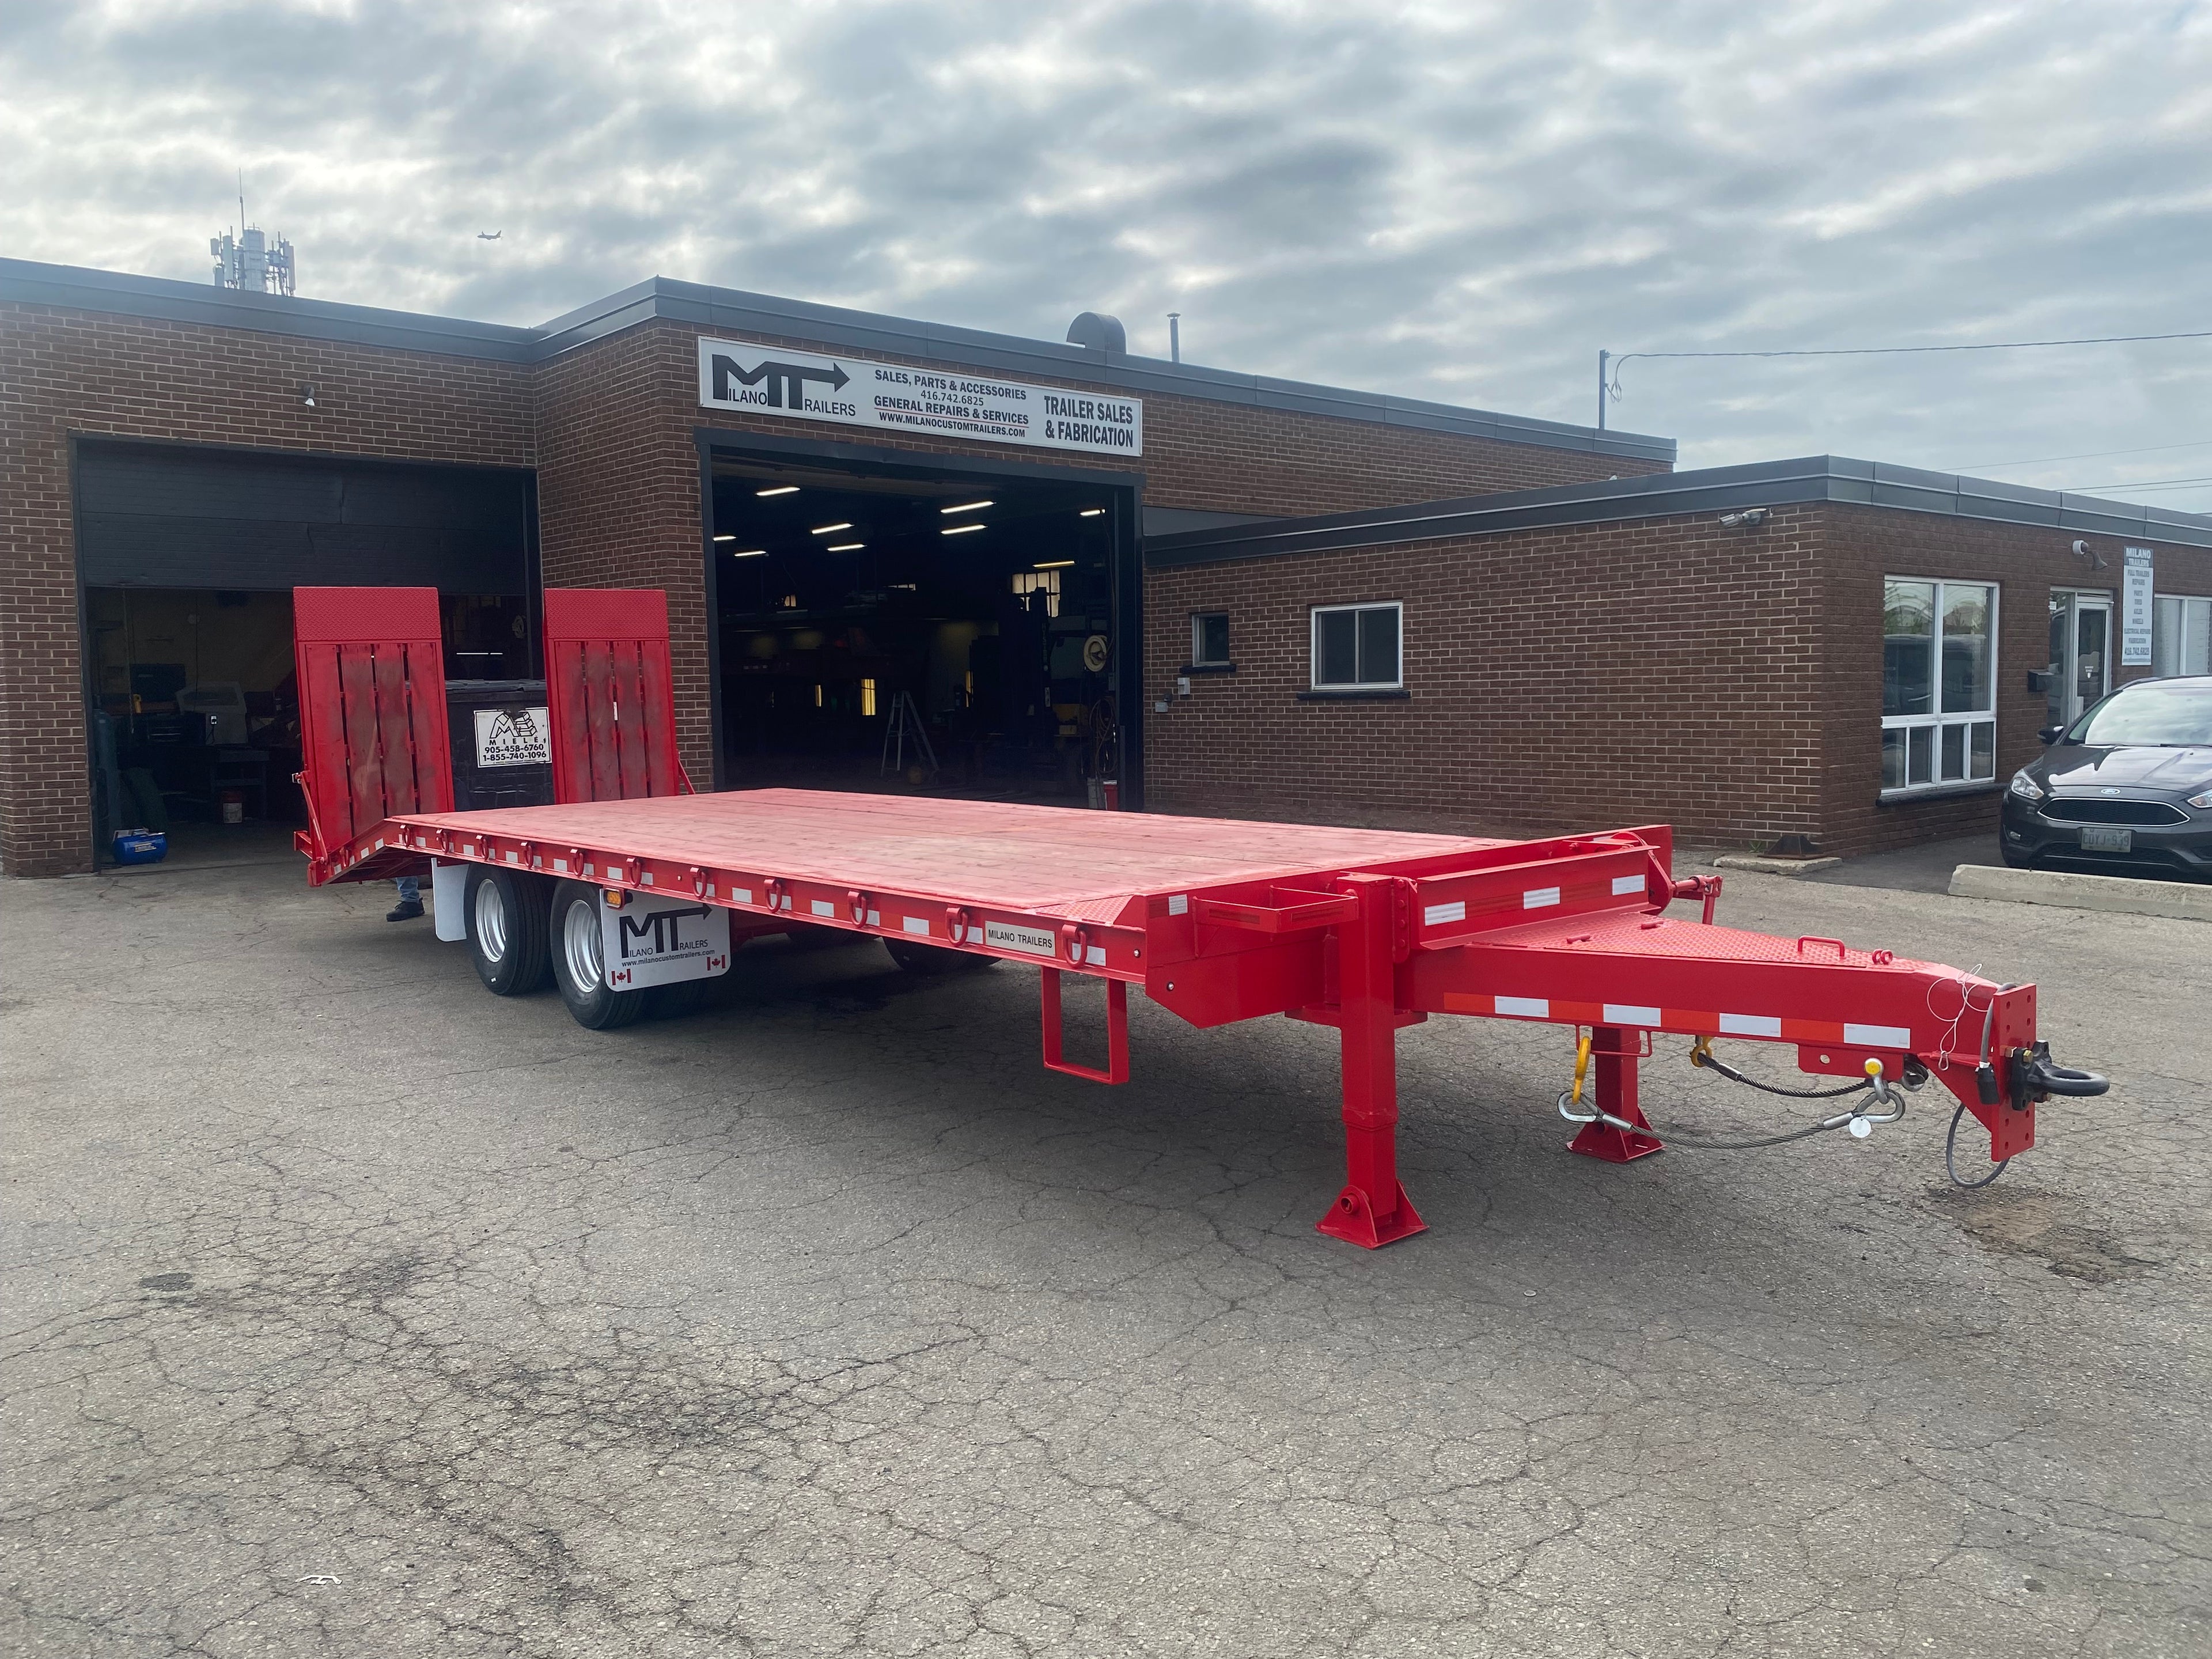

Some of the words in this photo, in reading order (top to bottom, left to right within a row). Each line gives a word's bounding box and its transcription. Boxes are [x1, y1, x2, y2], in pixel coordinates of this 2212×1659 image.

[874, 369, 911, 387] SALES,
[914, 375, 946, 389] PARTS
[949, 380, 957, 391] &
[960, 382, 1027, 400] ACCESSORIES
[921, 390, 984, 406] 416.742.6825
[874, 395, 923, 412] GENERAL
[925, 402, 969, 418] REPAIRS
[972, 408, 980, 419] &
[983, 410, 1029, 425] SERVICES
[1044, 395, 1094, 420] TRAILER
[1097, 403, 1133, 425] SALES
[879, 411, 1025, 438] WWW.MILANOCUSTOMTRAILERS.COM
[1046, 419, 1055, 439] &
[1058, 421, 1133, 448] FABRICATION
[2126, 547, 2151, 559] MILANO
[2128, 558, 2149, 567] TRAILERS
[484, 744, 544, 753] 905-458-6760
[489, 737, 539, 745] MIELE
[483, 751, 547, 762] 1-855-740-1096
[988, 929, 1015, 942] MILANO
[1018, 934, 1052, 949] TRAILERS
[622, 949, 715, 967] www.milanocustomtrailers.com
